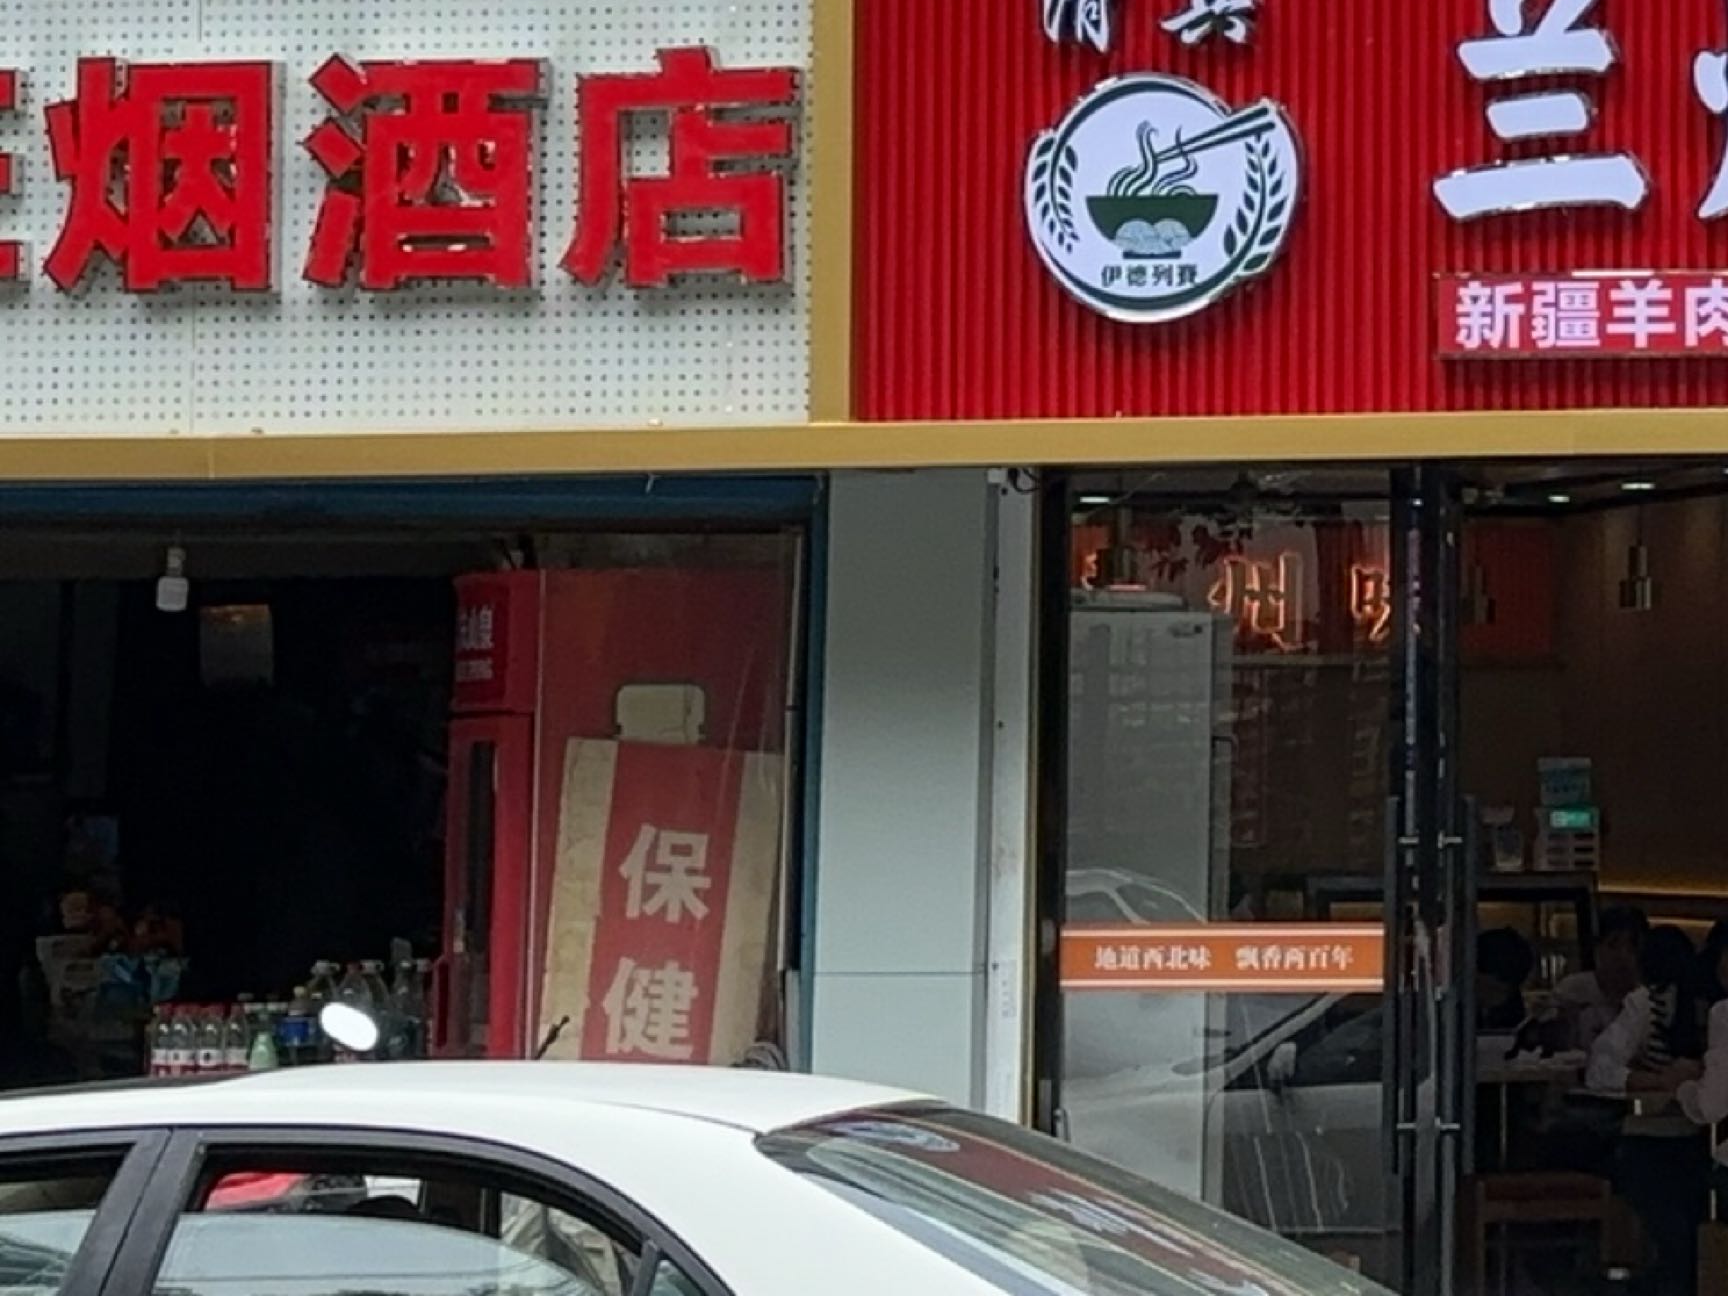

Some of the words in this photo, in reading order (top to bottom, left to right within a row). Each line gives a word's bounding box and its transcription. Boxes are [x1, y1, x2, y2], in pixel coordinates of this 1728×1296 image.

[0, 46, 799, 292] 烟酒店
[602, 822, 712, 1060] 保健
